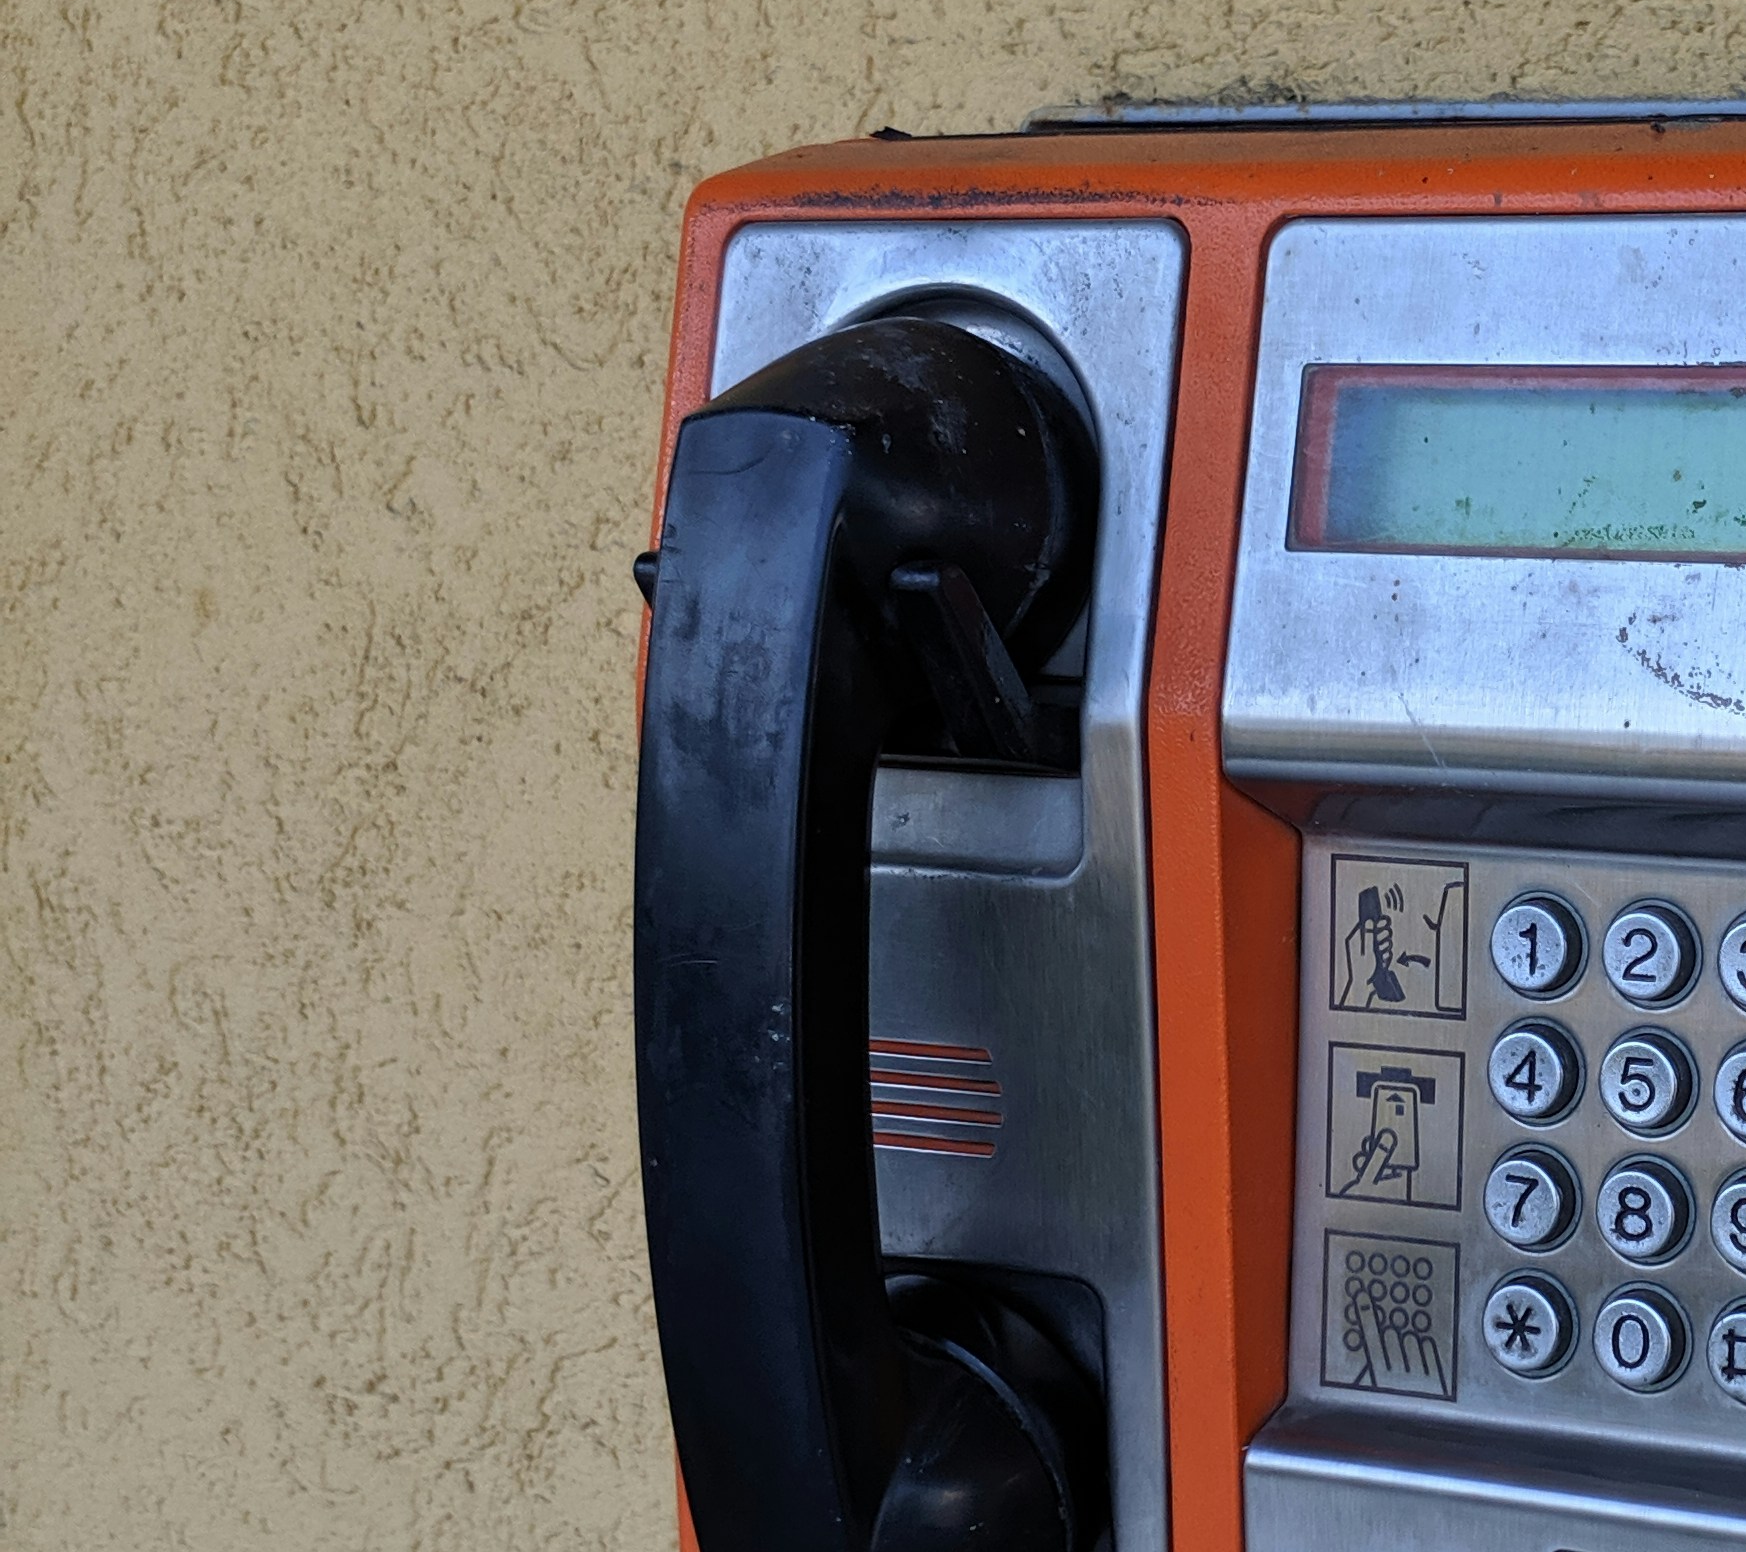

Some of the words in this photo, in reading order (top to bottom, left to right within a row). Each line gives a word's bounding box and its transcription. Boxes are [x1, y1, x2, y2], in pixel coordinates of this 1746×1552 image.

[1518, 922, 1538, 976] 1
[1622, 928, 1659, 983] 2
[1505, 1049, 1543, 1105] 4
[1618, 1056, 1657, 1113] 5
[1505, 1174, 1540, 1228] 7
[1612, 1186, 1653, 1243] 8
[1611, 1314, 1649, 1369] 0
